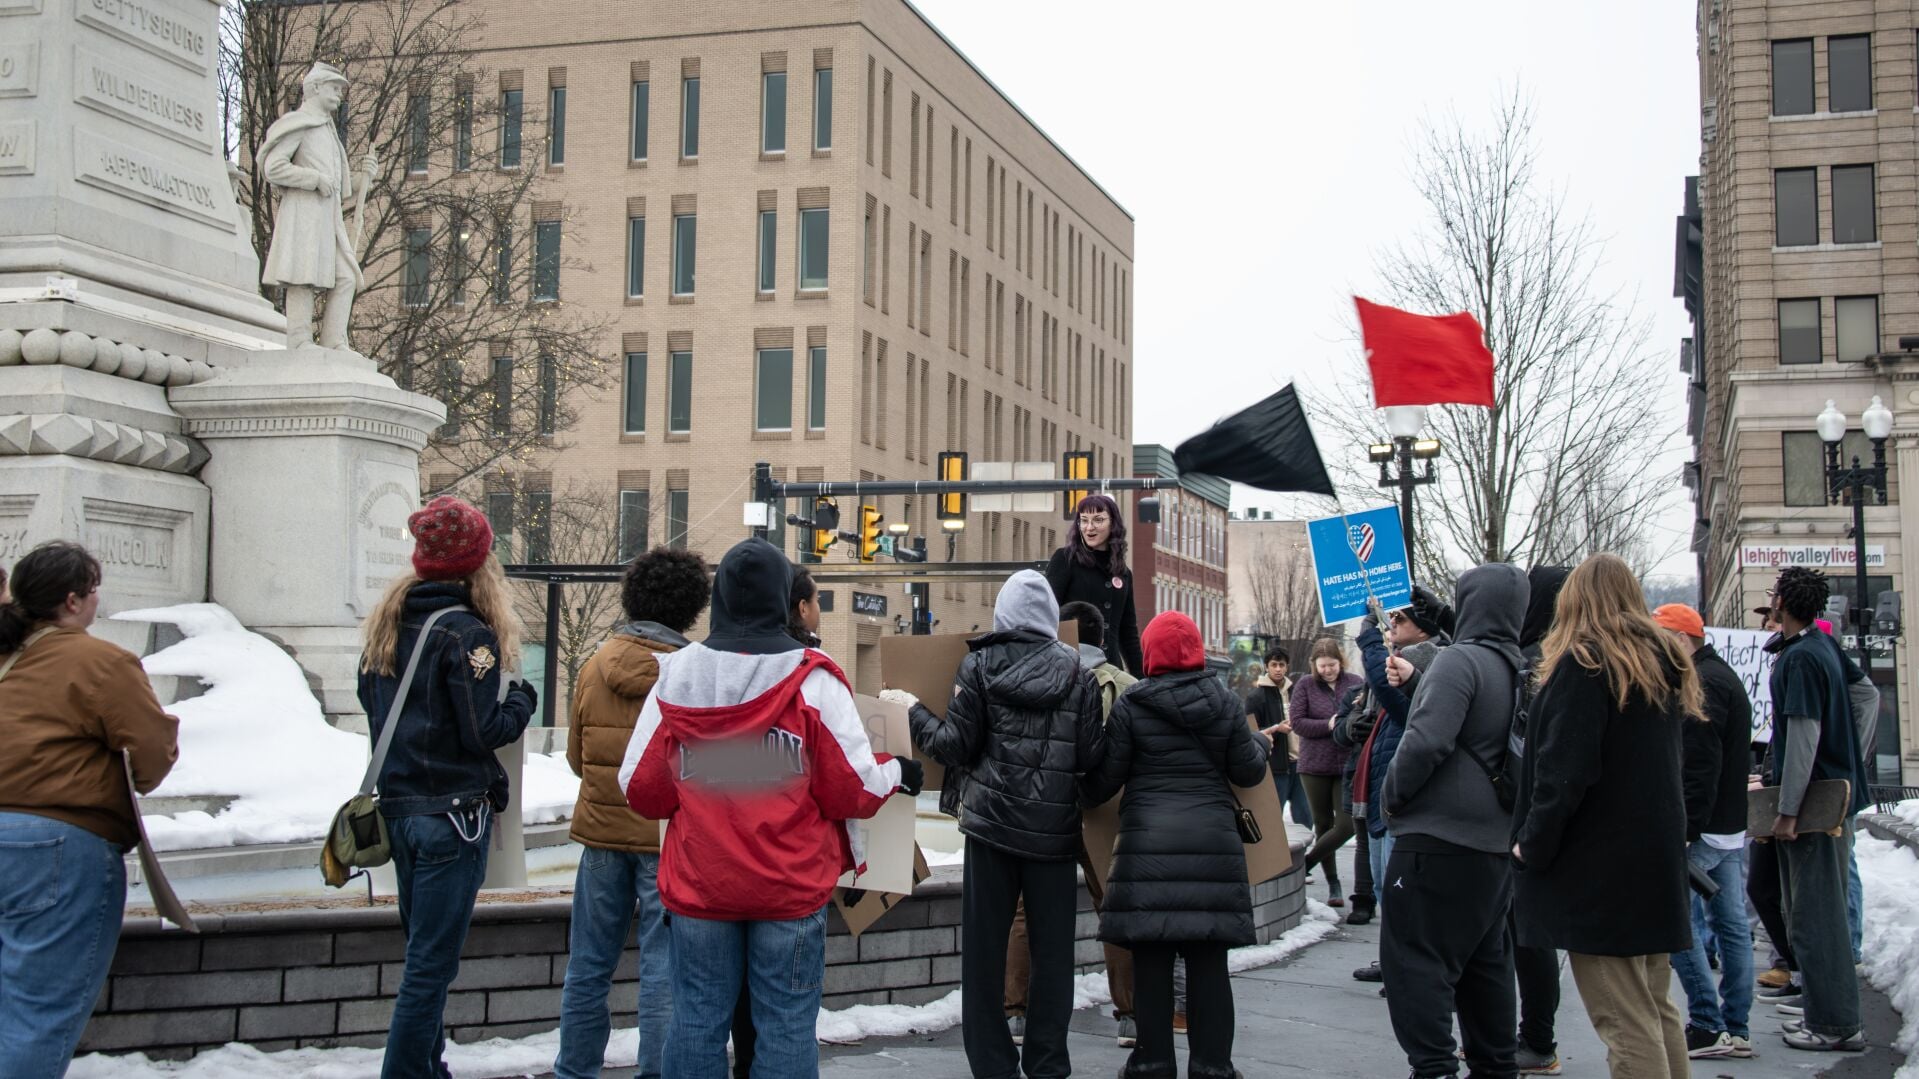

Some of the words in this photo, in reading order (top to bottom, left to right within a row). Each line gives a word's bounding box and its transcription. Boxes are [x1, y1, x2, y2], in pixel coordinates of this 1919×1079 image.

[92, 66, 205, 132] WILDERNESS
[102, 152, 216, 210] APPOMATTOX
[1323, 575, 1342, 586] HATE
[1343, 571, 1357, 581] HAS
[1358, 569, 1368, 579] NO
[1369, 565, 1387, 576] HOME
[1388, 562, 1404, 572] HERE.
[1743, 546, 1882, 566] lehighvalleyliveom
[1704, 630, 1759, 667] otect
